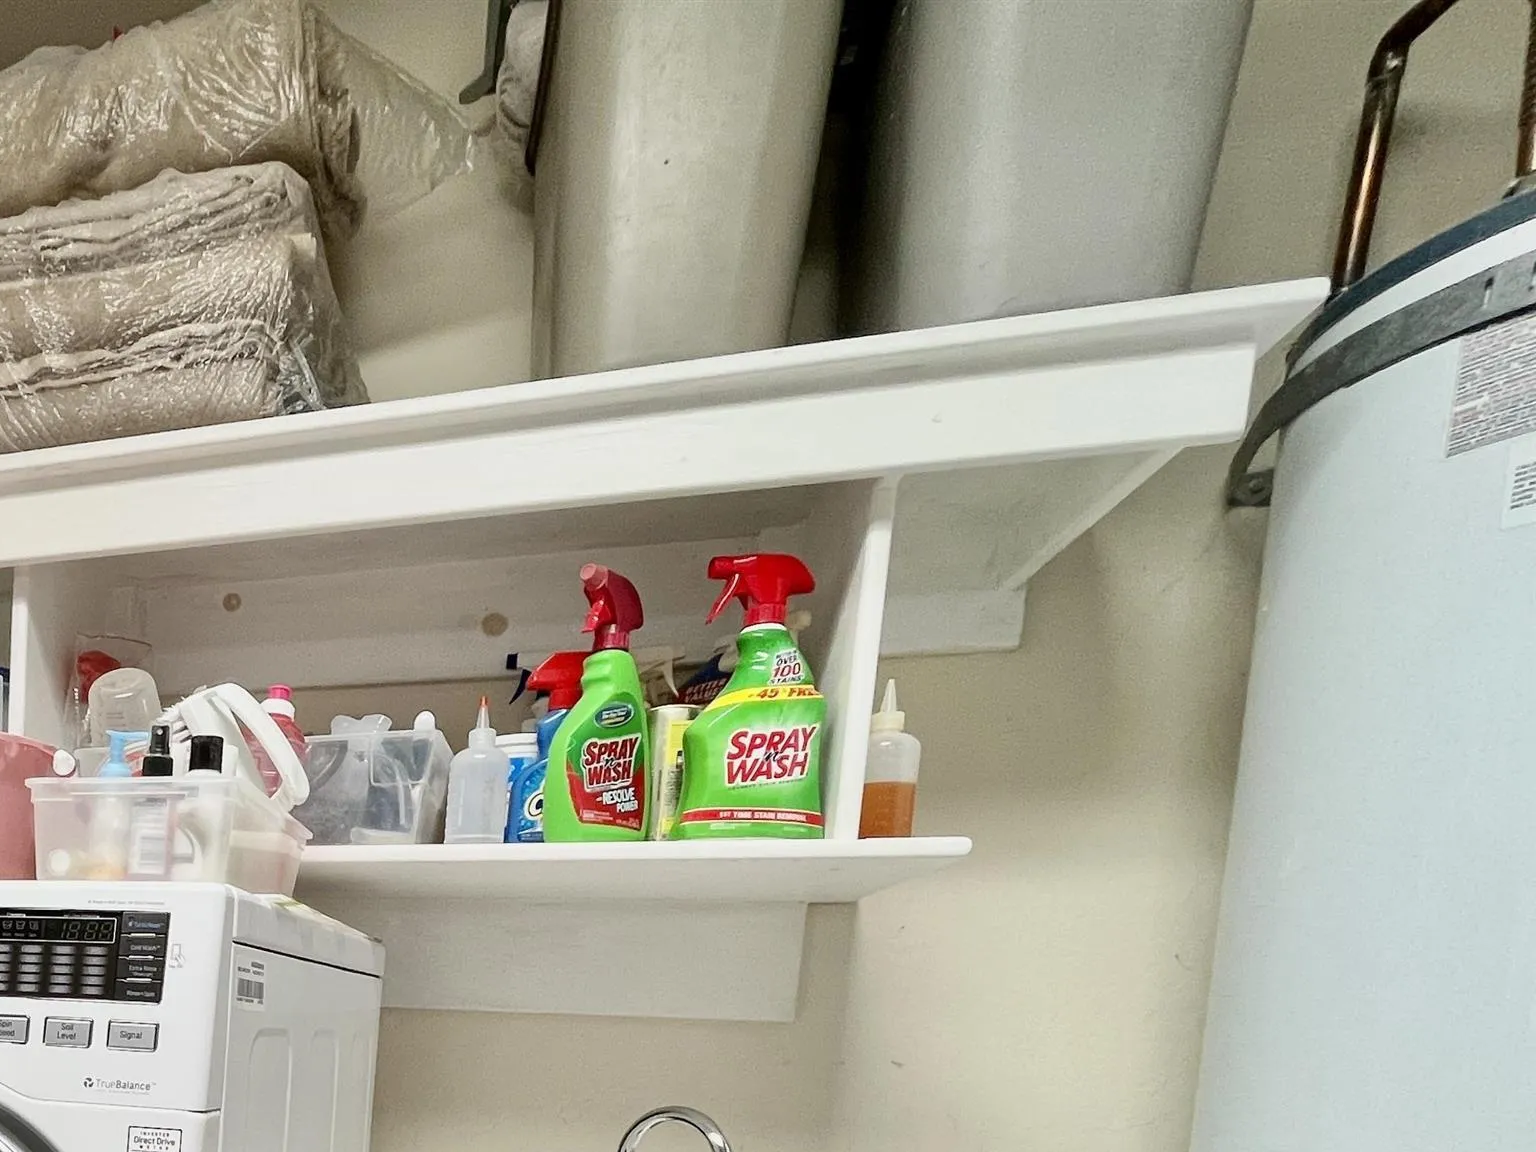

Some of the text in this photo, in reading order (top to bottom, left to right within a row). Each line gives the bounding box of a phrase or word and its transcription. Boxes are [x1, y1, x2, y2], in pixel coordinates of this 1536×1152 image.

[773, 663, 801, 678] 100
[585, 736, 640, 766] SPRAY
[727, 727, 817, 760] SPRAY
[586, 759, 633, 786] WASH
[727, 752, 809, 784] WASH
[603, 787, 636, 804] RESOLVE
[61, 1023, 74, 1031] Soil
[56, 1031, 77, 1040] Level
[119, 1030, 143, 1041] Signal
[133, 1135, 176, 1147] Direct Drive
